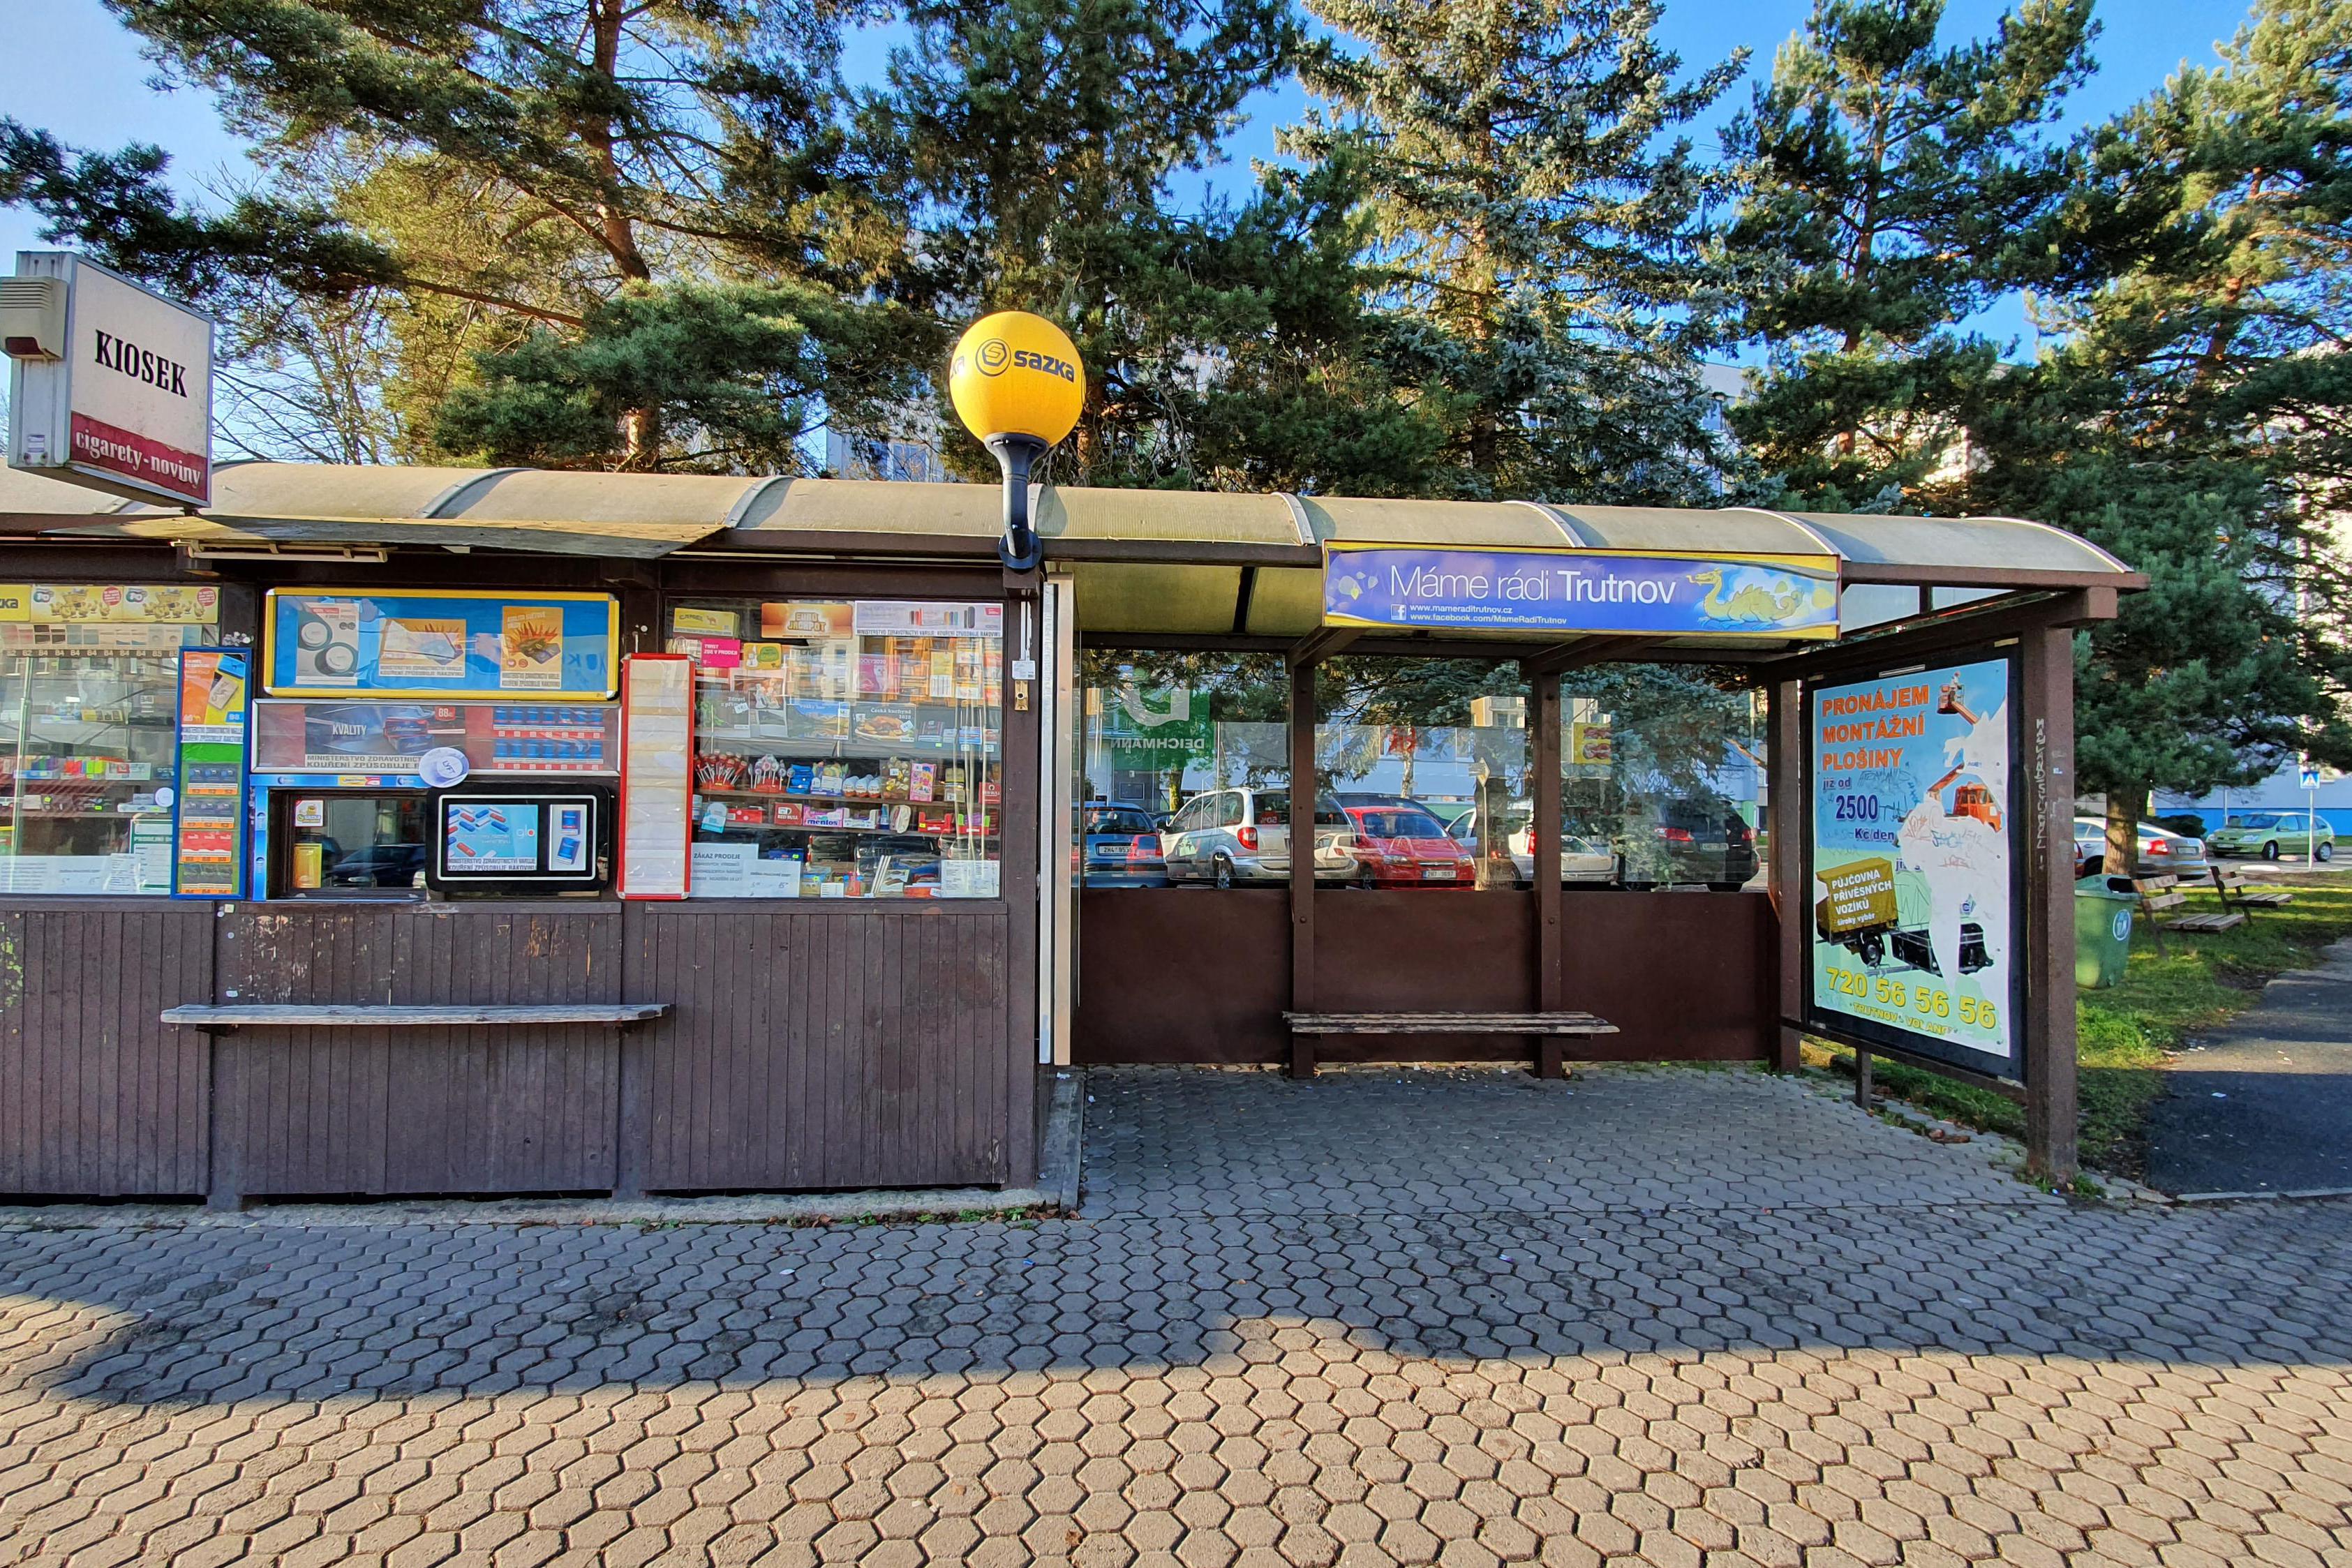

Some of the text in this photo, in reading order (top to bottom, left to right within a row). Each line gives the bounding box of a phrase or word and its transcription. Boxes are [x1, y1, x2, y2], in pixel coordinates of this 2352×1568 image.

[95, 329, 188, 398] KIOSEK
[1013, 350, 1075, 383] sazka
[75, 428, 143, 472] cigarety
[151, 455, 202, 488] noviny
[1390, 565, 1676, 604] Máme rádi Trutnov
[1410, 604, 1513, 614] www.mameraditrutnov.cz
[1410, 613, 1568, 625] www.facebook.com/MameRadiTrutnov
[1822, 684, 1930, 717] PRONÁJEM
[332, 724, 367, 736] KVALITY
[1822, 710, 1926, 744] MONTÁŽNÍ
[1822, 747, 1904, 771] PLOŠINY
[1838, 777, 1851, 788] od
[1836, 794, 1879, 821] 2500
[1831, 869, 1881, 890] PŮJČOVNA
[1833, 880, 1892, 902] PŘÍVĚSNÝCH
[1836, 897, 1870, 915] VOZÍKŮ
[1826, 966, 1997, 1029] 720 56 56 56
